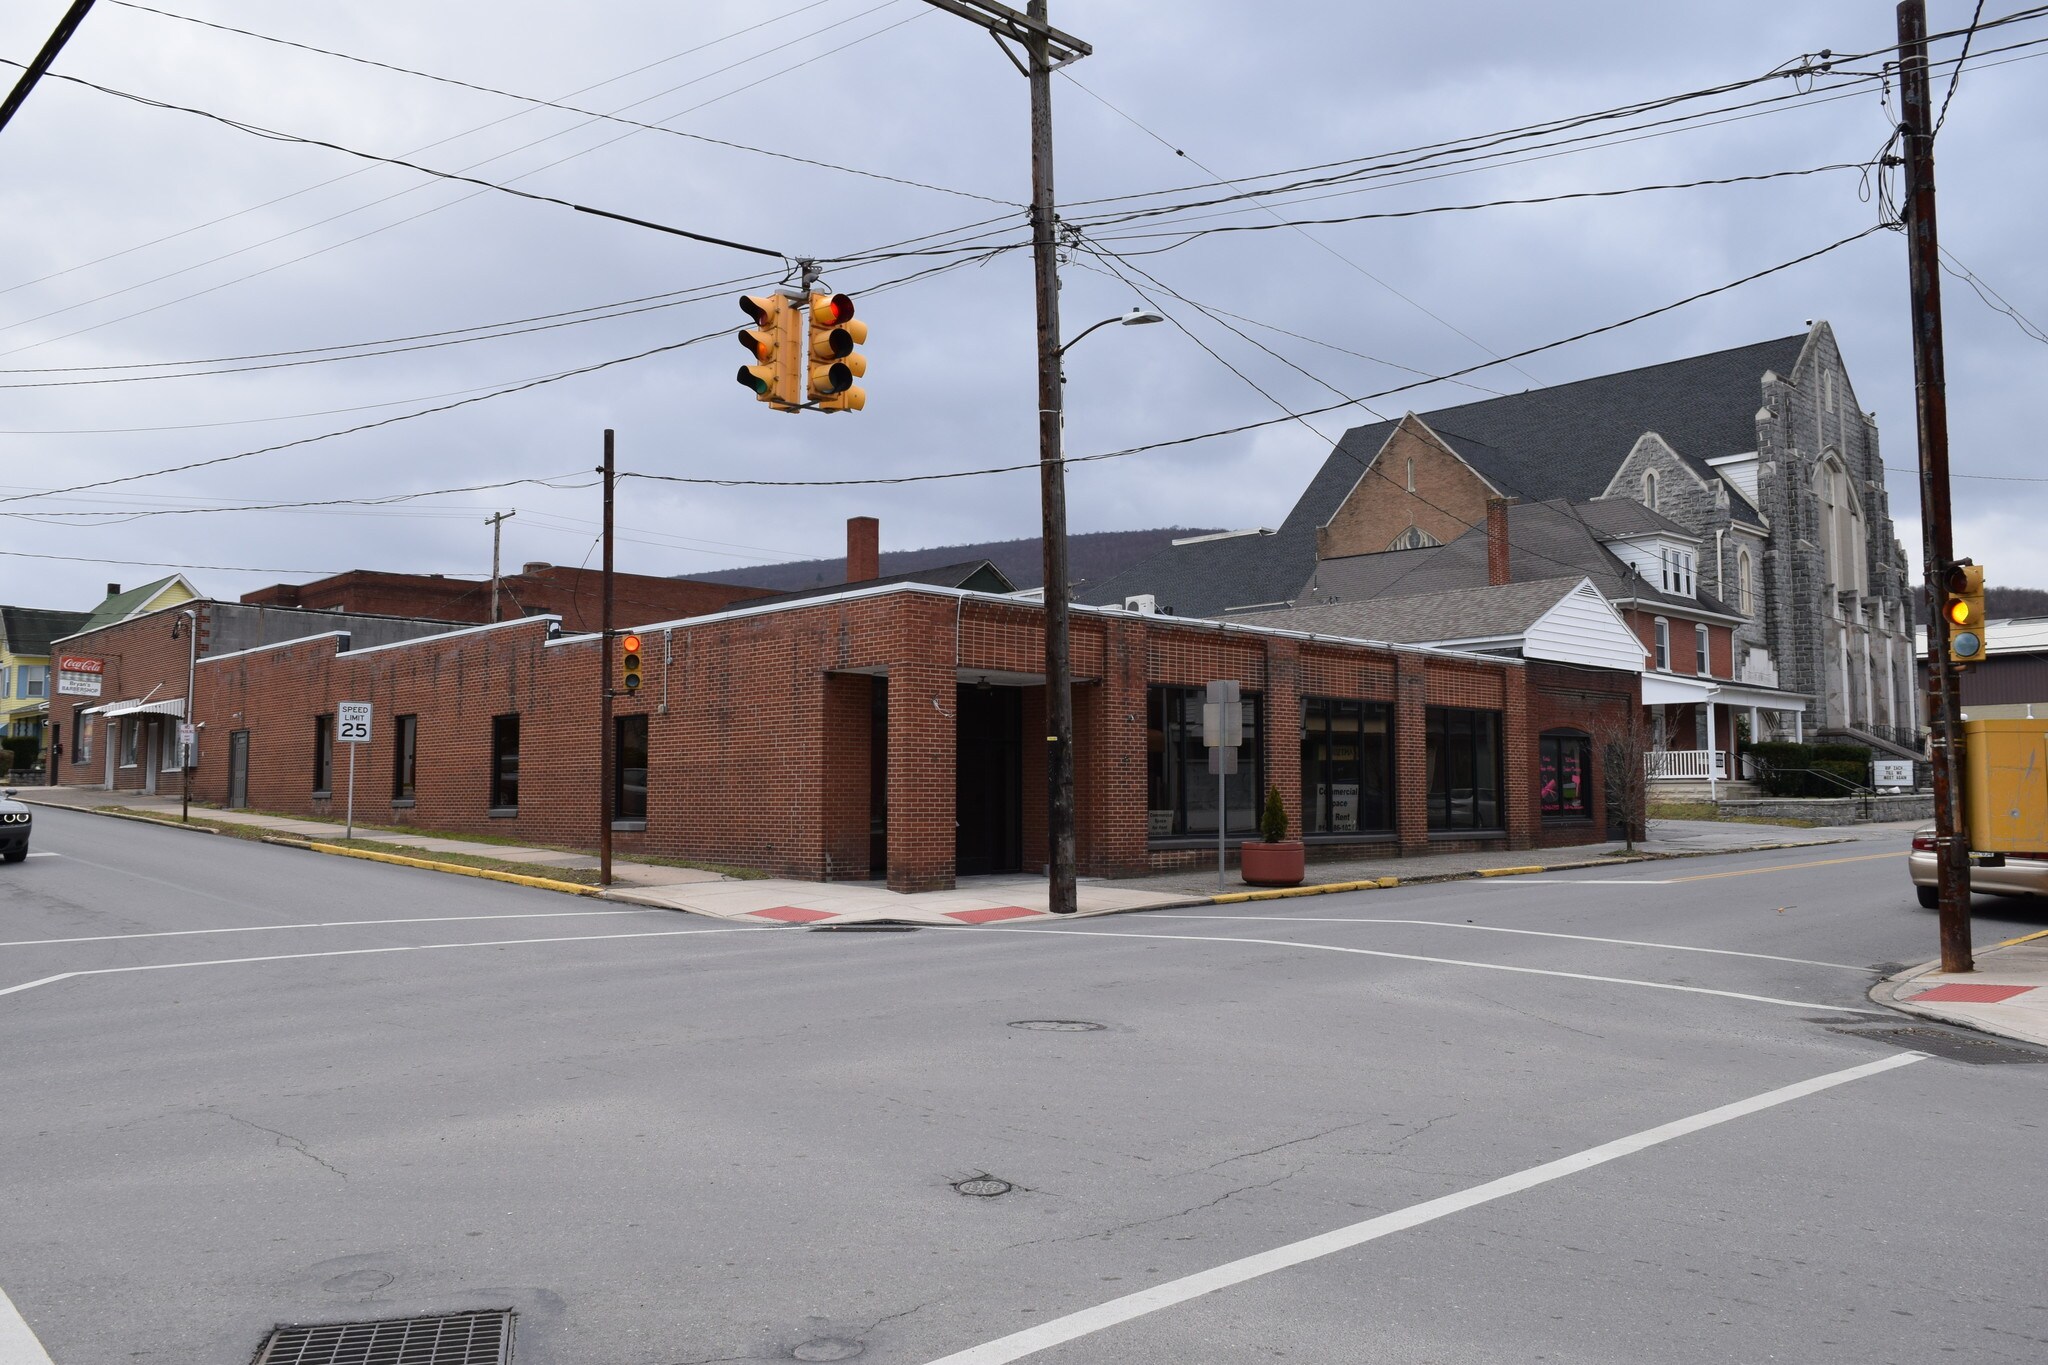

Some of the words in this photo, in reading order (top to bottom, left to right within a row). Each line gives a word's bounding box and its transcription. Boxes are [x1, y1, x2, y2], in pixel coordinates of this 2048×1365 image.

[62, 685, 99, 693] BARBERSHOP
[342, 706, 369, 714] SPEED
[341, 722, 367, 738] 25
[1318, 787, 1358, 796] Comercial
[1335, 813, 1350, 821] Rent
